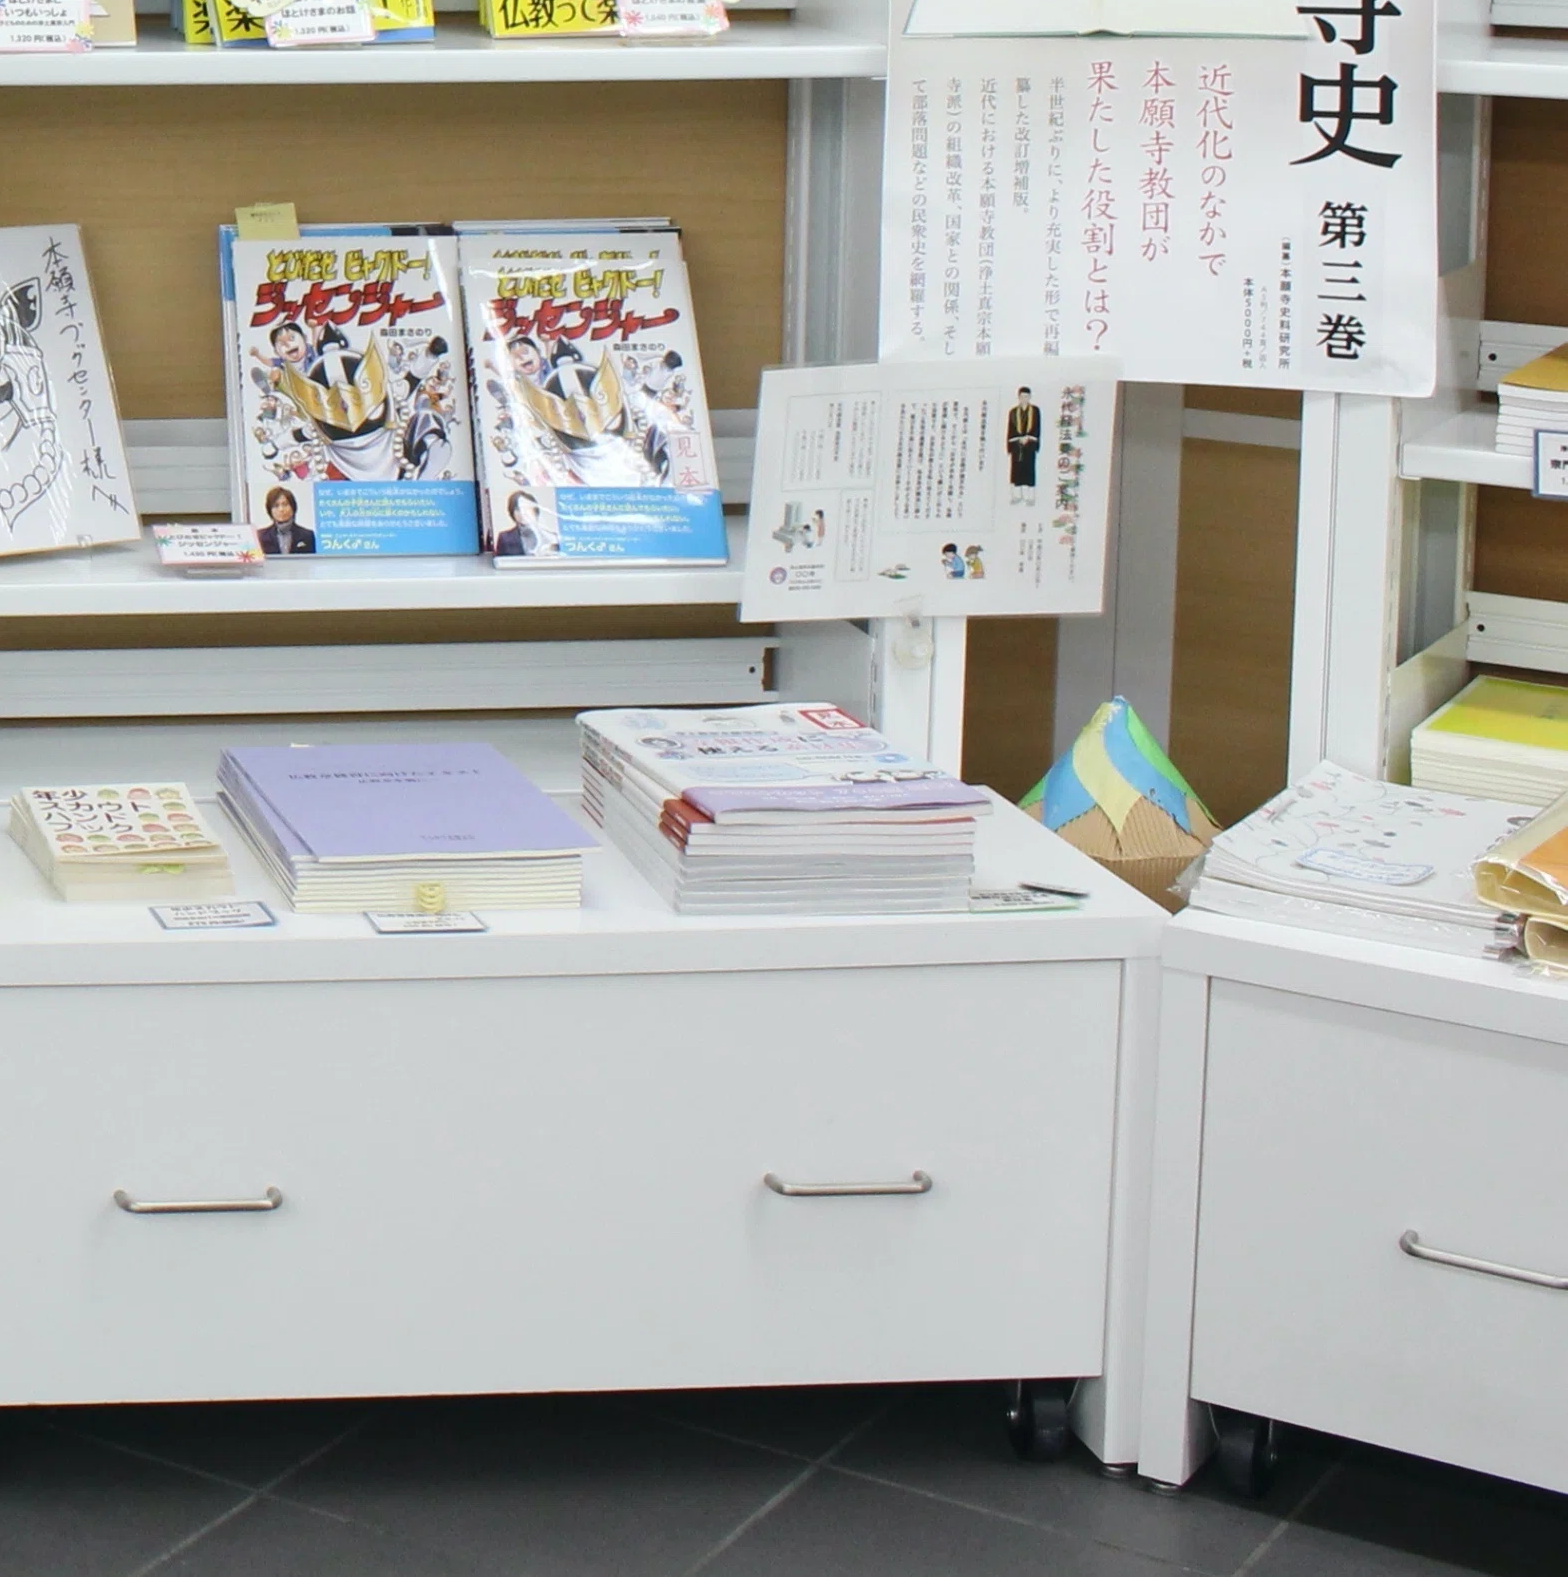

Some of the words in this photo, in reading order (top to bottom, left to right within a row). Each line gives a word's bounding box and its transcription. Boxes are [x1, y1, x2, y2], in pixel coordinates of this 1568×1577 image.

[3, 8, 68, 18] いつもいっしょ
[1137, 60, 1176, 262] 本願寺教団が
[1195, 63, 1234, 277] 近代化のなかで
[1080, 60, 1119, 352] 果たした役割とは？
[250, 281, 444, 328] ジッセンジャー
[1316, 200, 1369, 361] 第三巻
[675, 436, 701, 488] 見本
[32, 788, 89, 801] 年少
[39, 801, 152, 813] スカウト
[44, 812, 129, 823] ハンド
